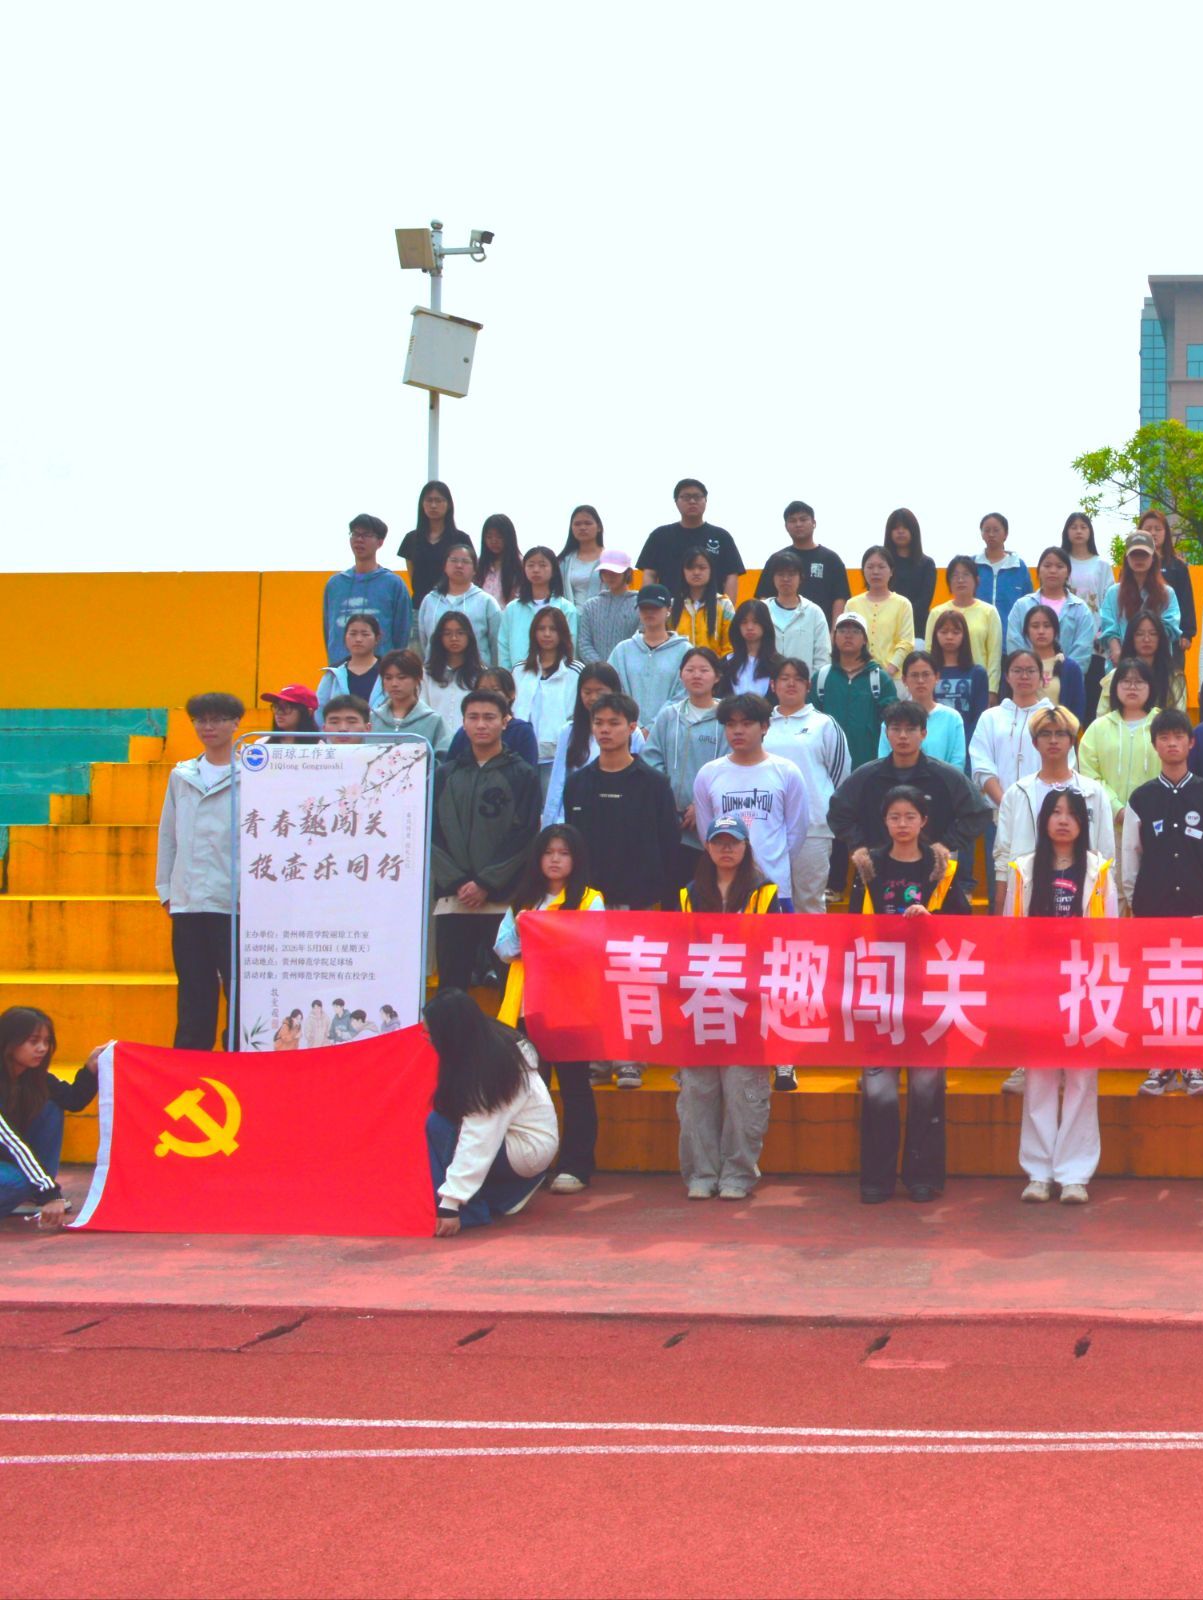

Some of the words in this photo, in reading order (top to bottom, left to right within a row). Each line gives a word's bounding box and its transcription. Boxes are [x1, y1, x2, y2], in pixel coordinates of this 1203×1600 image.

[272, 746, 337, 760] 丽琼工作室
[241, 809, 388, 839] 青春趣闯关
[248, 852, 405, 883] 投壶乐同行
[604, 934, 988, 1048] 青春趣闯关
